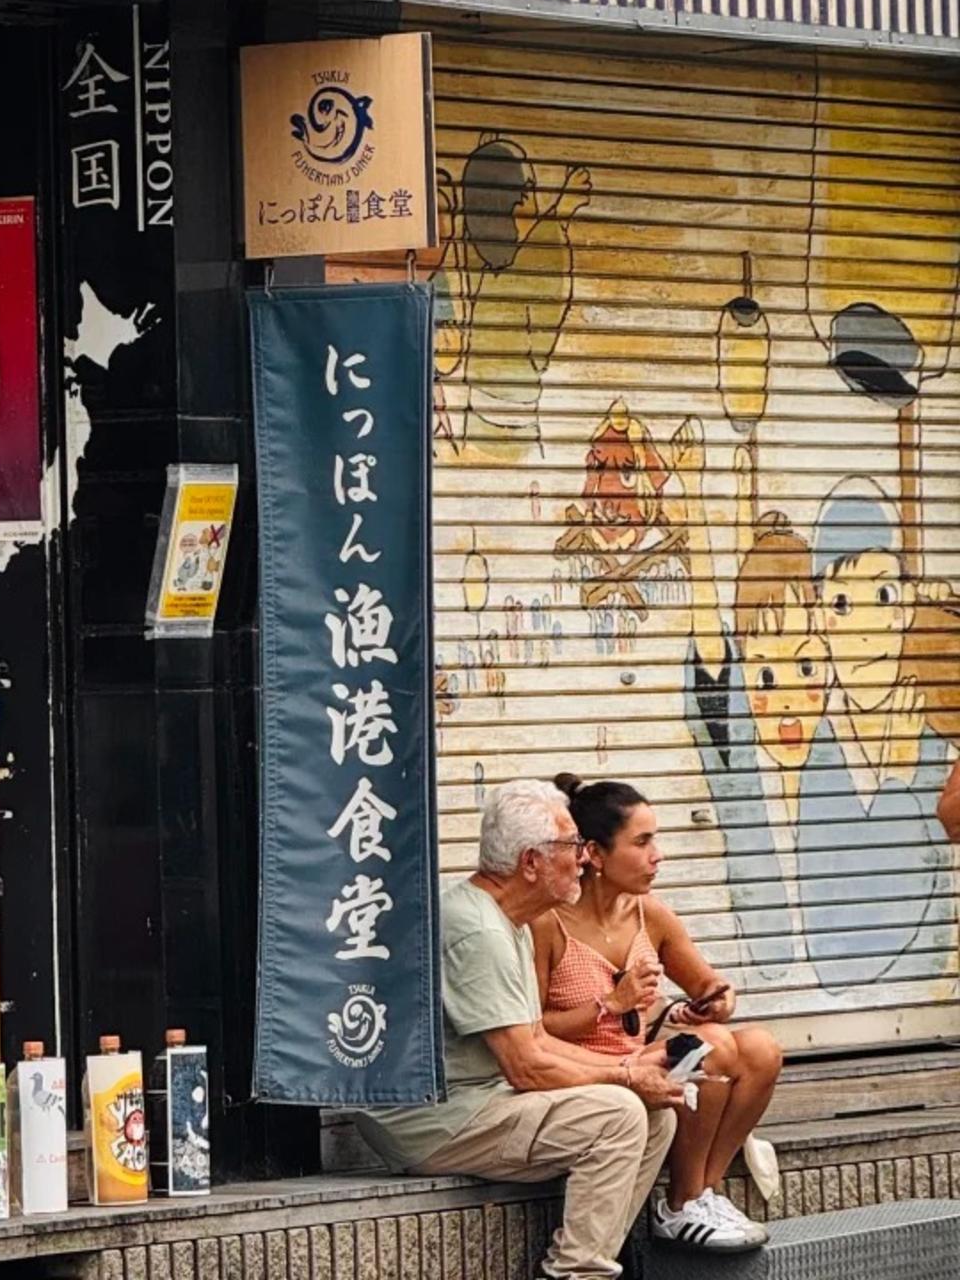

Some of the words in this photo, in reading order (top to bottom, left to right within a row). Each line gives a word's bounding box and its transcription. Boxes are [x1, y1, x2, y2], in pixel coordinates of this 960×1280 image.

[61, 42, 131, 211] 全国
[143, 40, 175, 228] NIPPON
[323, 344, 399, 962] にっぽん漁港食堂
